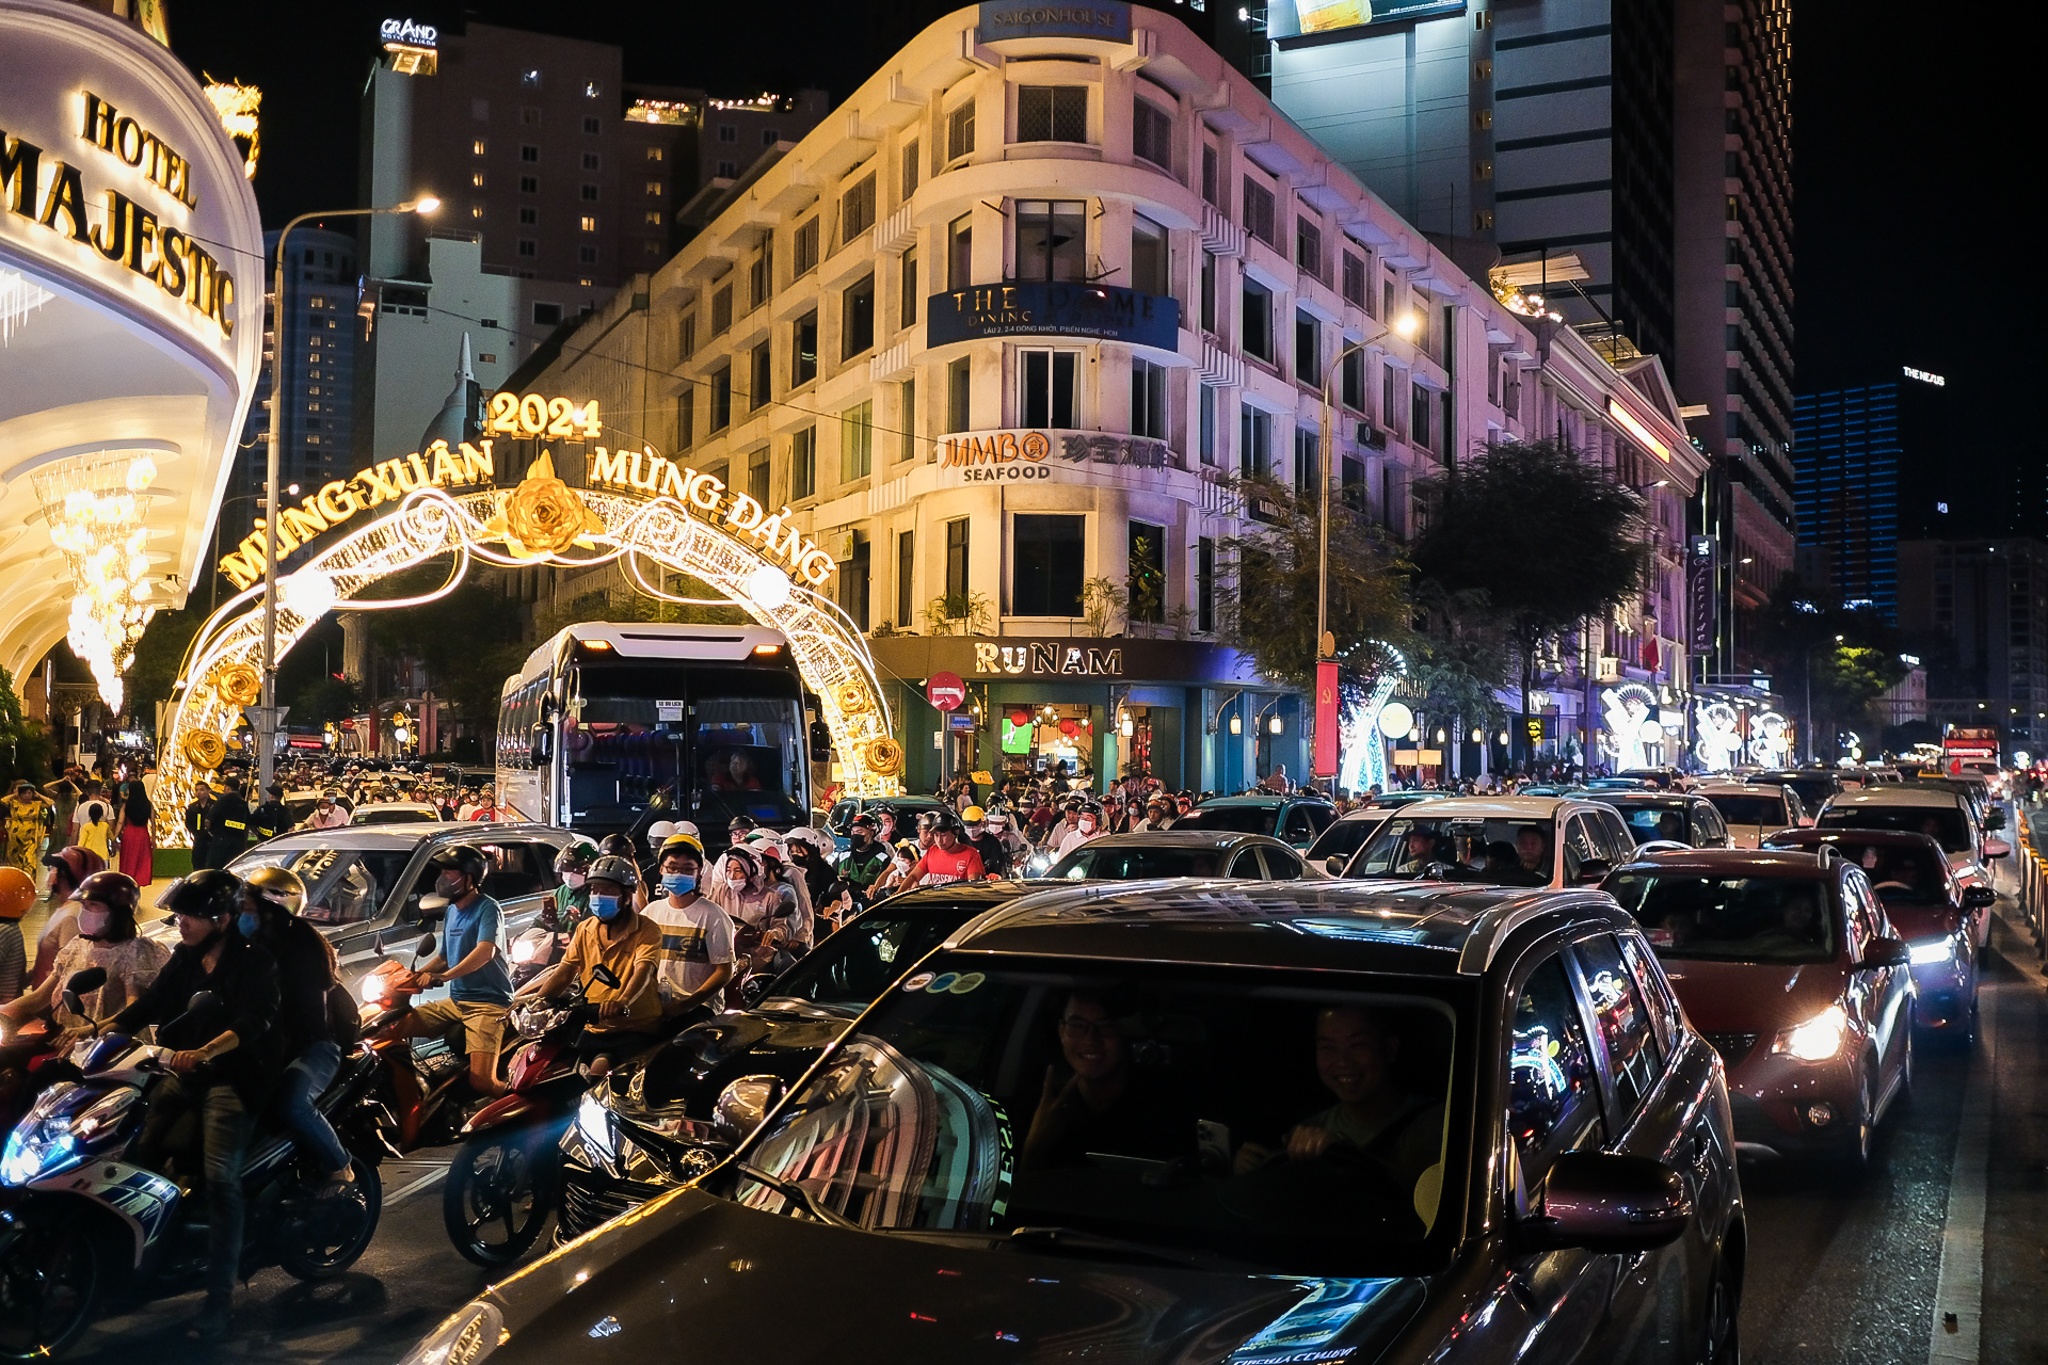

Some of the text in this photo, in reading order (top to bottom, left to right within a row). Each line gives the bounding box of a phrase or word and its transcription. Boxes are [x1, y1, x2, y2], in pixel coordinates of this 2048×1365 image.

[381, 18, 437, 40] GRAND
[81, 91, 197, 211] HOTEL
[0, 129, 234, 340] MAJESTIC
[953, 287, 1018, 312] THE
[1903, 366, 1919, 380] THE
[492, 392, 602, 438] 2024
[941, 432, 1049, 469] JUMBO
[357, 438, 494, 506] XUÂN
[963, 466, 1050, 482] SEAFOOD
